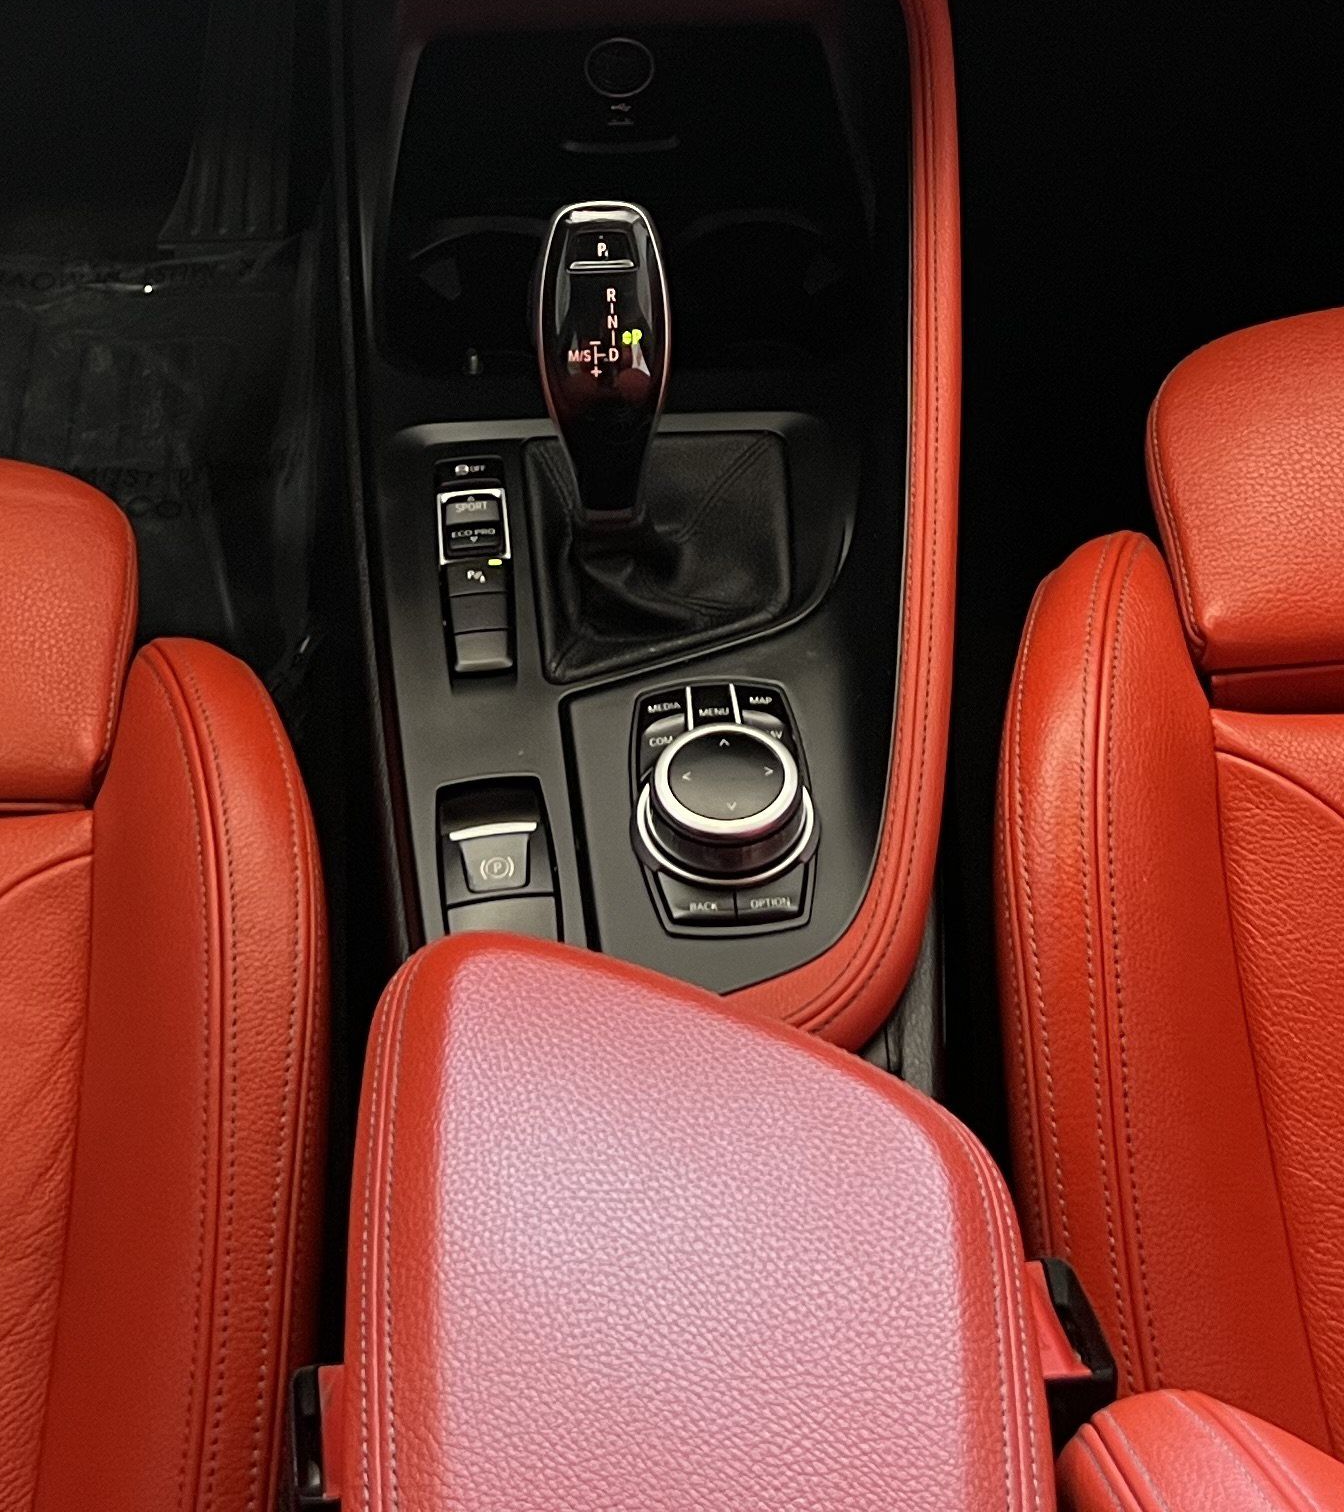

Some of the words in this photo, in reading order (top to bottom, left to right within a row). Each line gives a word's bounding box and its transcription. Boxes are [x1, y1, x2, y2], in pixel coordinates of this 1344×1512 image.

[597, 242, 606, 257] P
[606, 288, 616, 302] R
[607, 315, 618, 329] N
[568, 349, 591, 362] M/S
[608, 348, 619, 362] D
[455, 500, 488, 513] SPORT
[451, 529, 473, 538] ECO
[749, 696, 773, 705] MAP
[647, 701, 681, 714] MEDIA
[698, 707, 730, 717] MENU
[689, 901, 718, 912] BACK
[750, 896, 791, 909] OPTION
